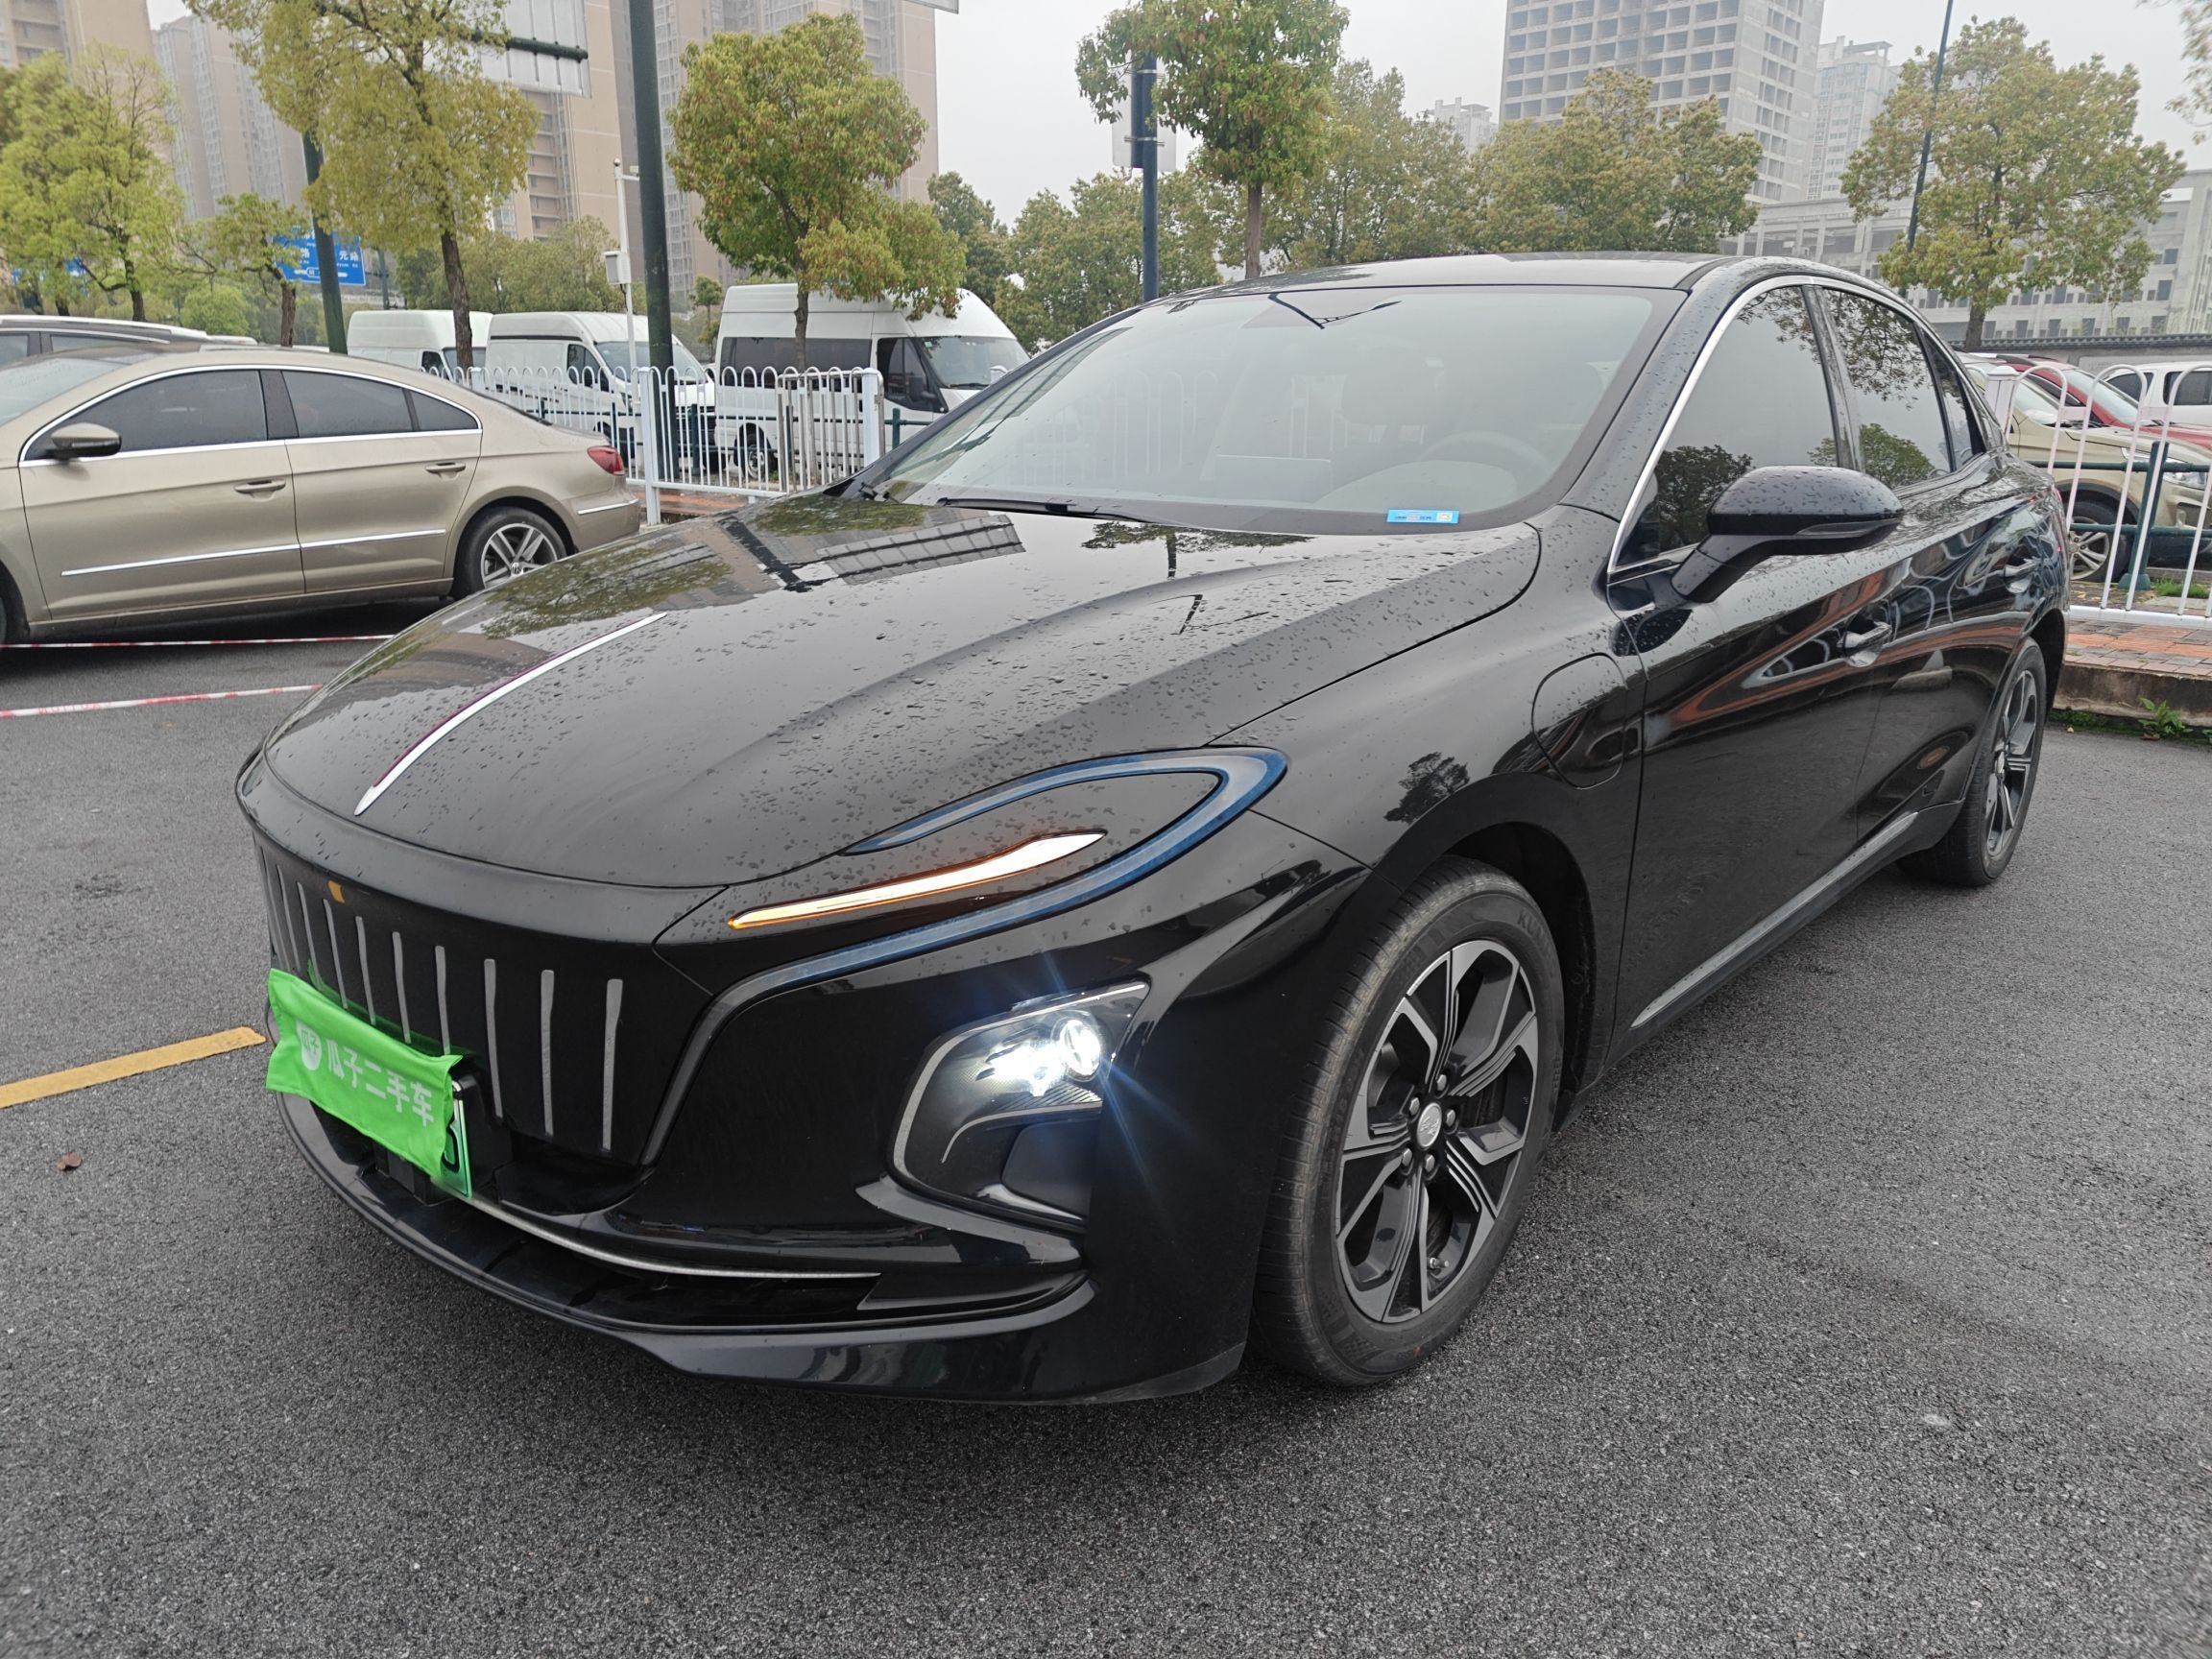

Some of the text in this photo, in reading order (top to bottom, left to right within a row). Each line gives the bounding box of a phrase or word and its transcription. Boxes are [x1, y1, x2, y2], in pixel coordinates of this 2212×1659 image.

[326, 1039, 434, 1127] 瓜子二手车
